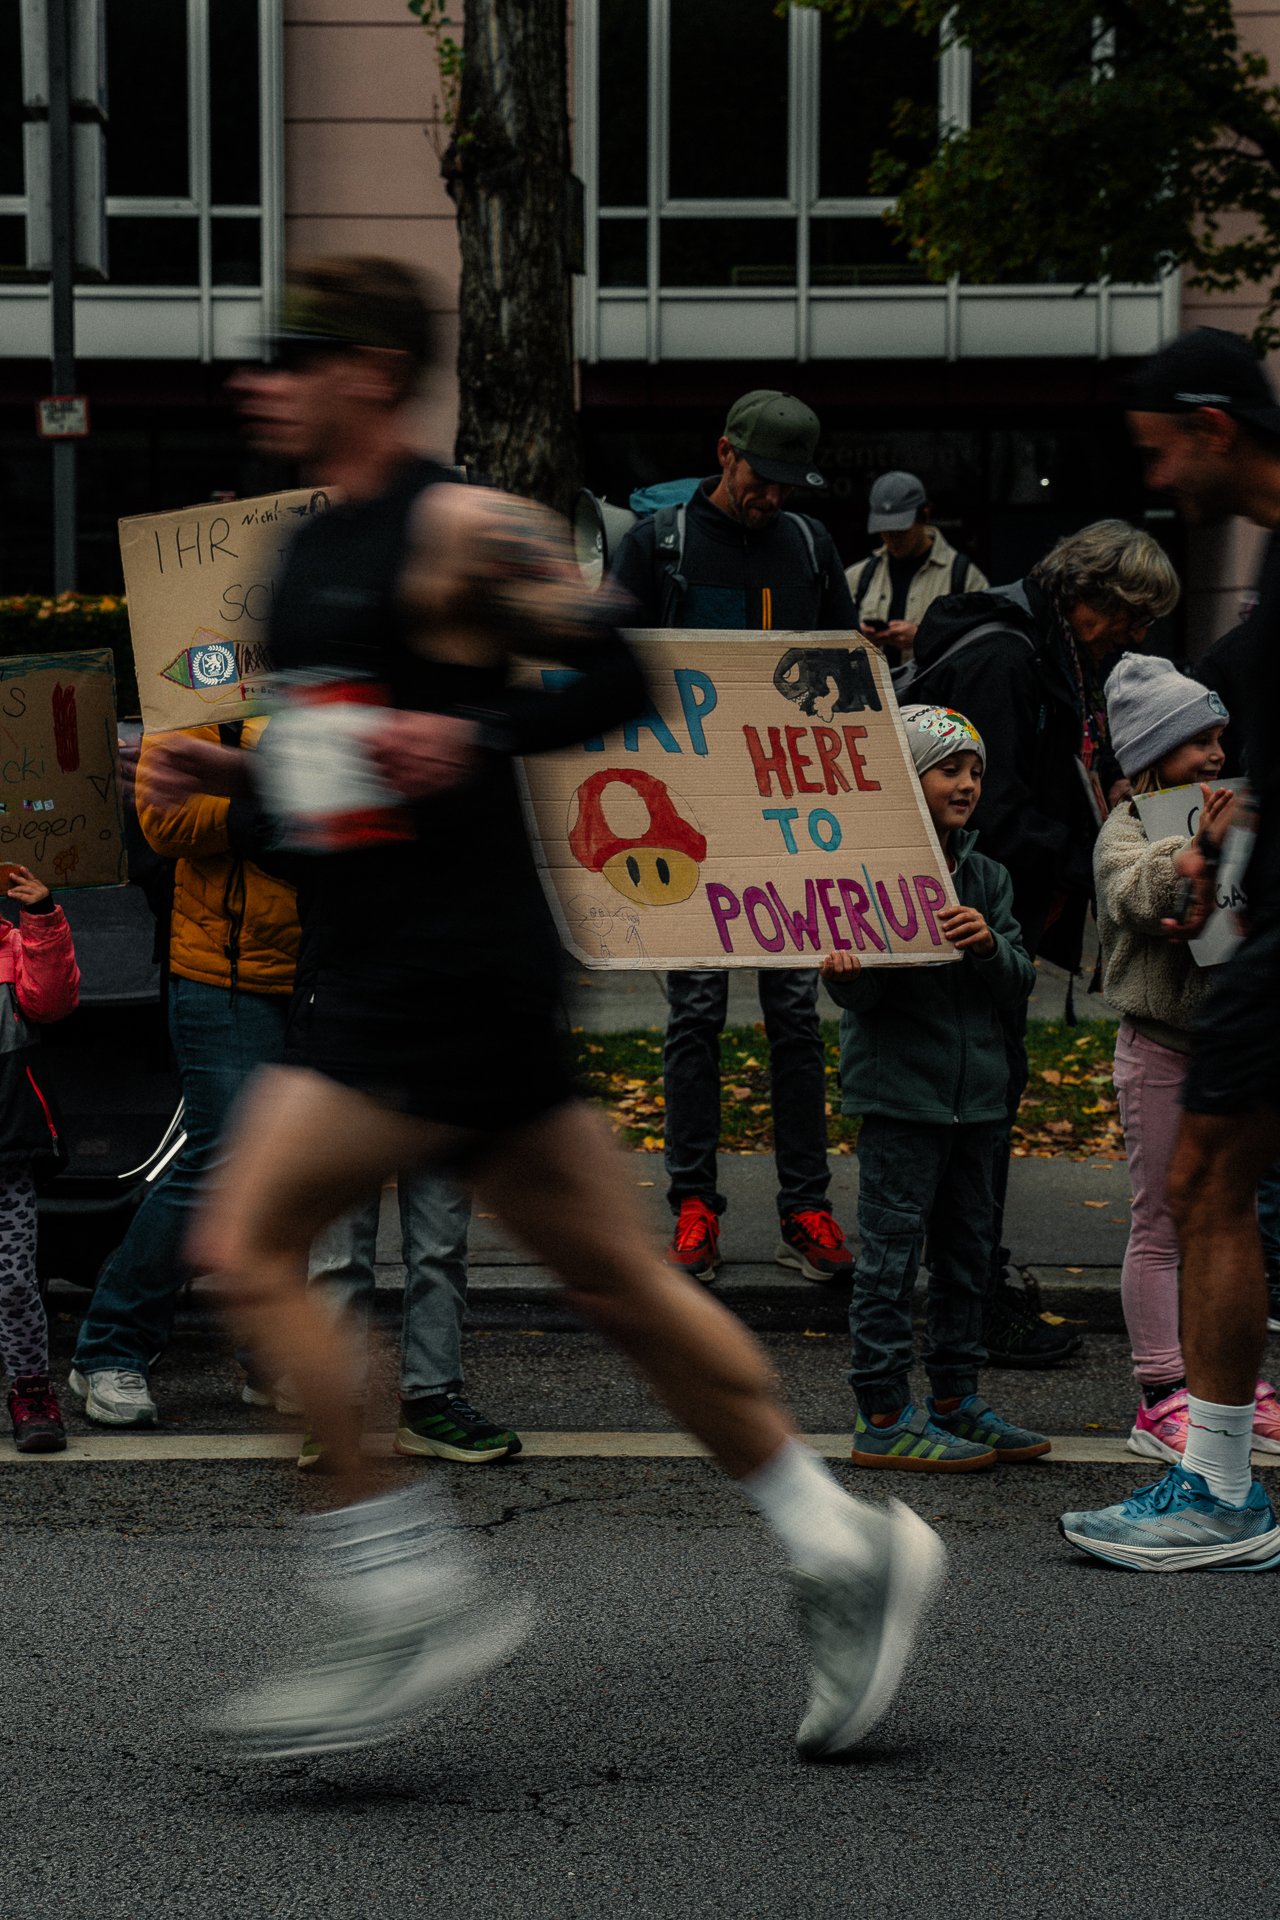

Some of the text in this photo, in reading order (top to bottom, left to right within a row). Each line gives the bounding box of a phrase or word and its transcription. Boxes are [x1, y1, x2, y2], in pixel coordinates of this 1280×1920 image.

[154, 517, 239, 574] IHR
[742, 724, 882, 799] HERE
[762, 807, 842, 855] TO
[705, 873, 947, 953] POWER UP
